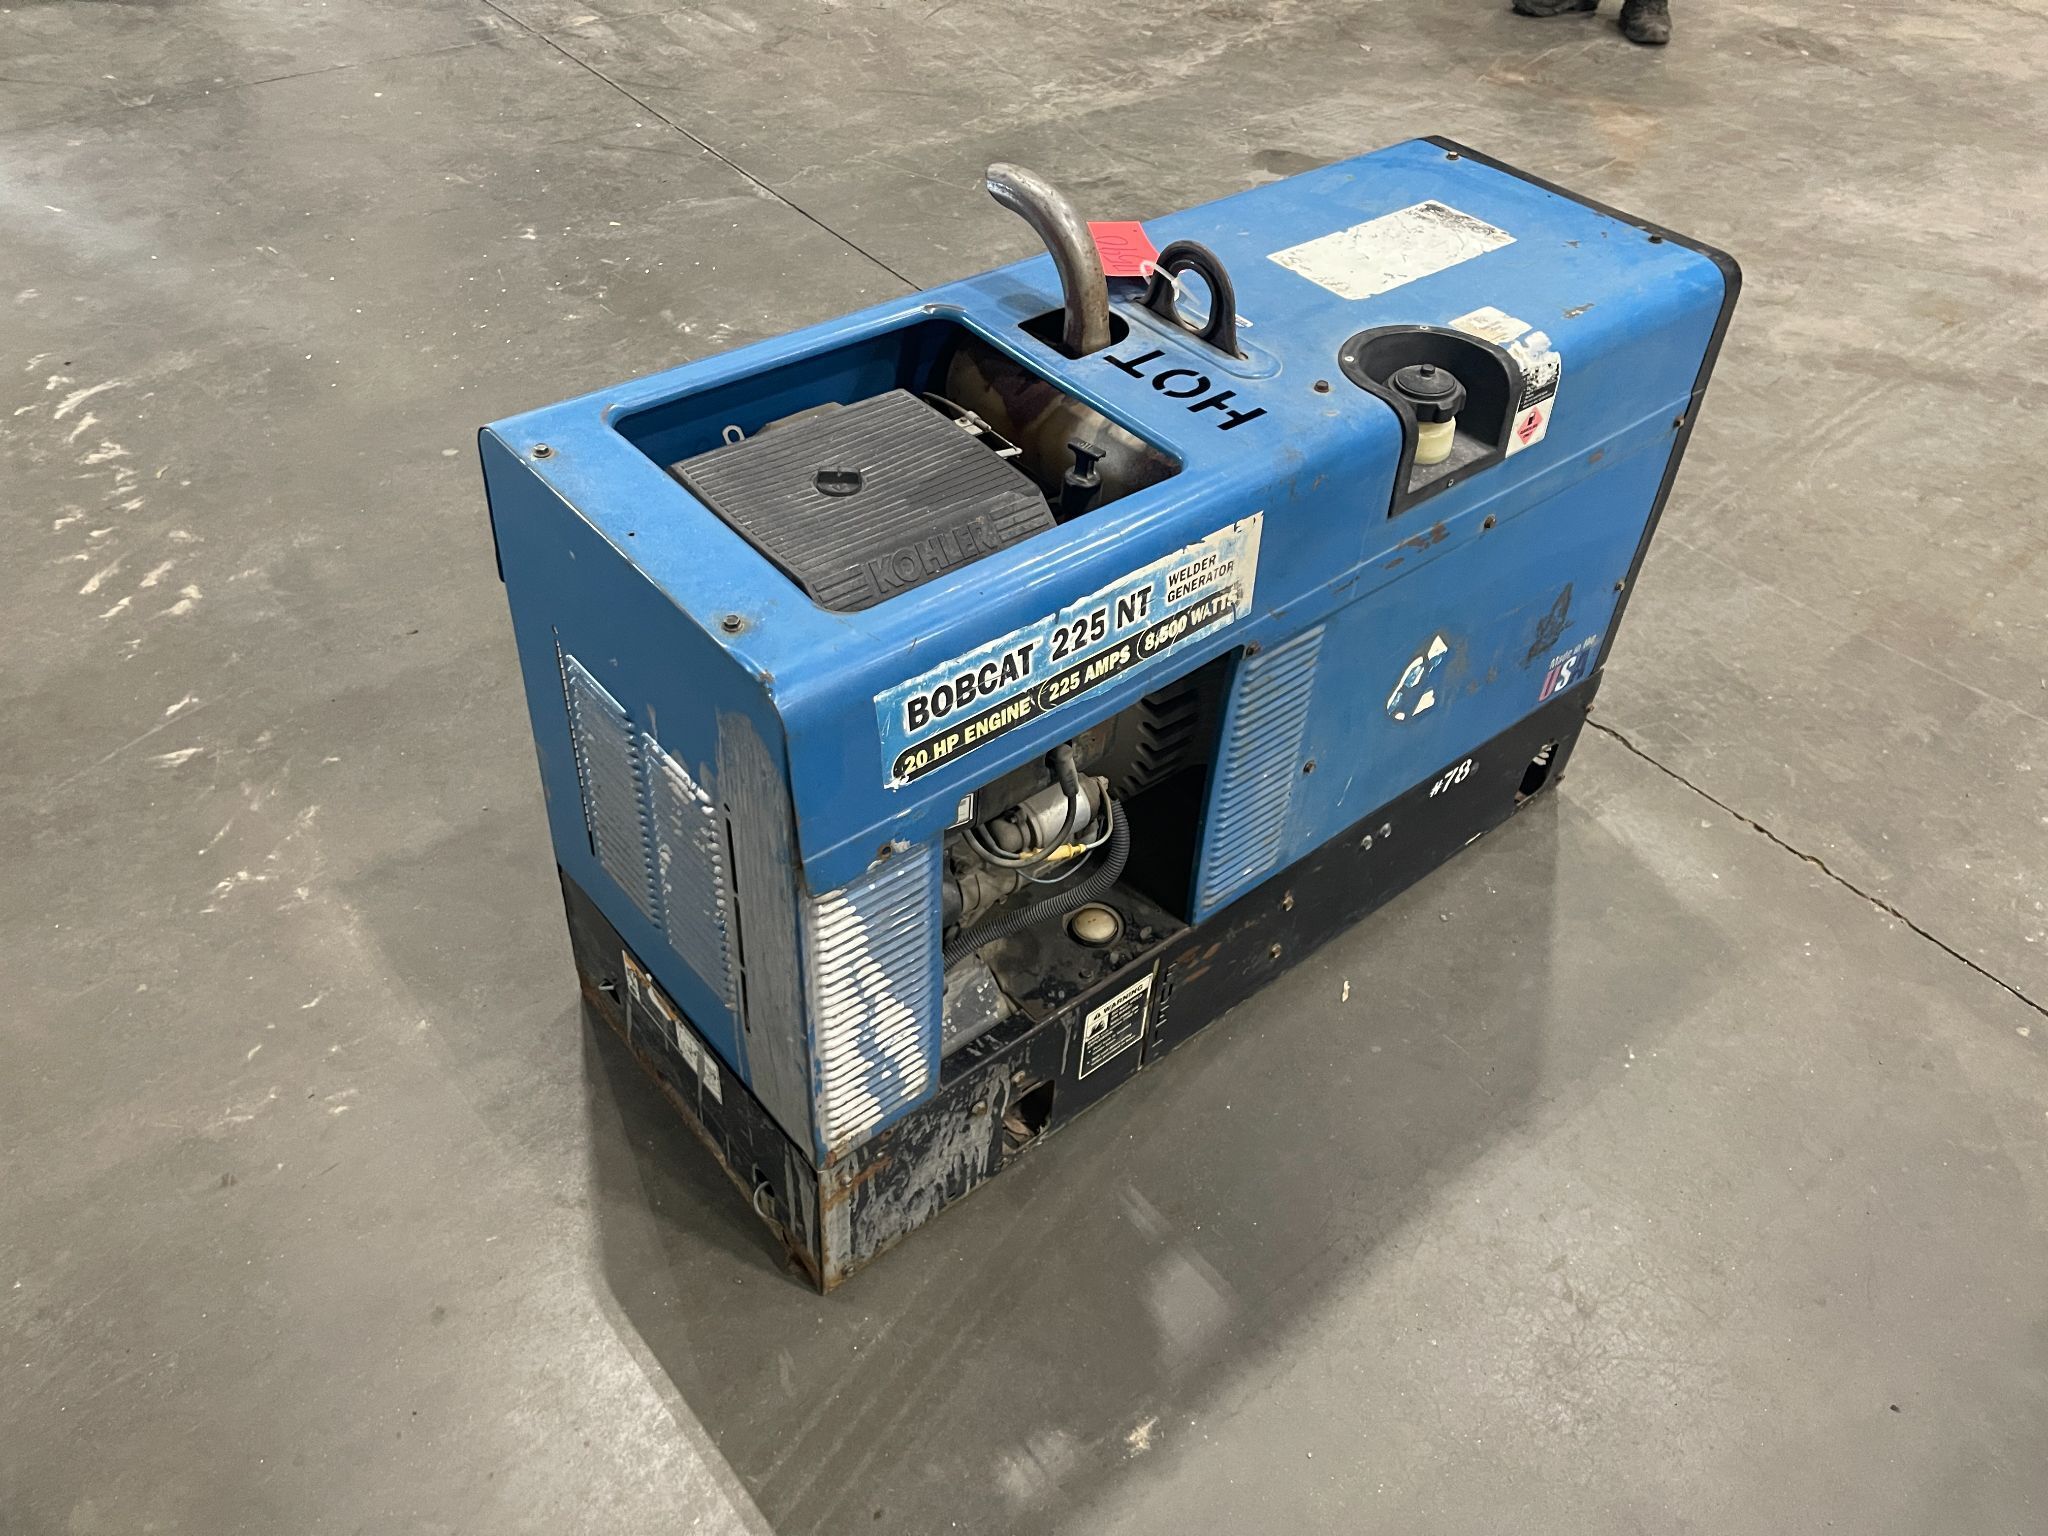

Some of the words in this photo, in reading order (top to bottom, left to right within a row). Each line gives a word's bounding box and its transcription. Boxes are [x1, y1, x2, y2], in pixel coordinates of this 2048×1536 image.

[1103, 349, 1268, 431] HOT
[867, 515, 999, 594] KOHLER
[1168, 554, 1217, 588] WELDER
[1167, 560, 1234, 603] GENERATOR
[907, 642, 1034, 732] BOBCAT
[1052, 608, 1106, 662] 225
[1117, 585, 1152, 629] NT
[1144, 614, 1188, 651] 8,500
[1048, 671, 1081, 702] 225
[1084, 644, 1131, 684] AMPS
[1538, 649, 1590, 702] USA
[904, 749, 929, 773] 20
[933, 733, 960, 760] HP
[964, 696, 1032, 745] ENGINE
[1429, 758, 1473, 798] #78
[1103, 984, 1144, 1014] WARNING
